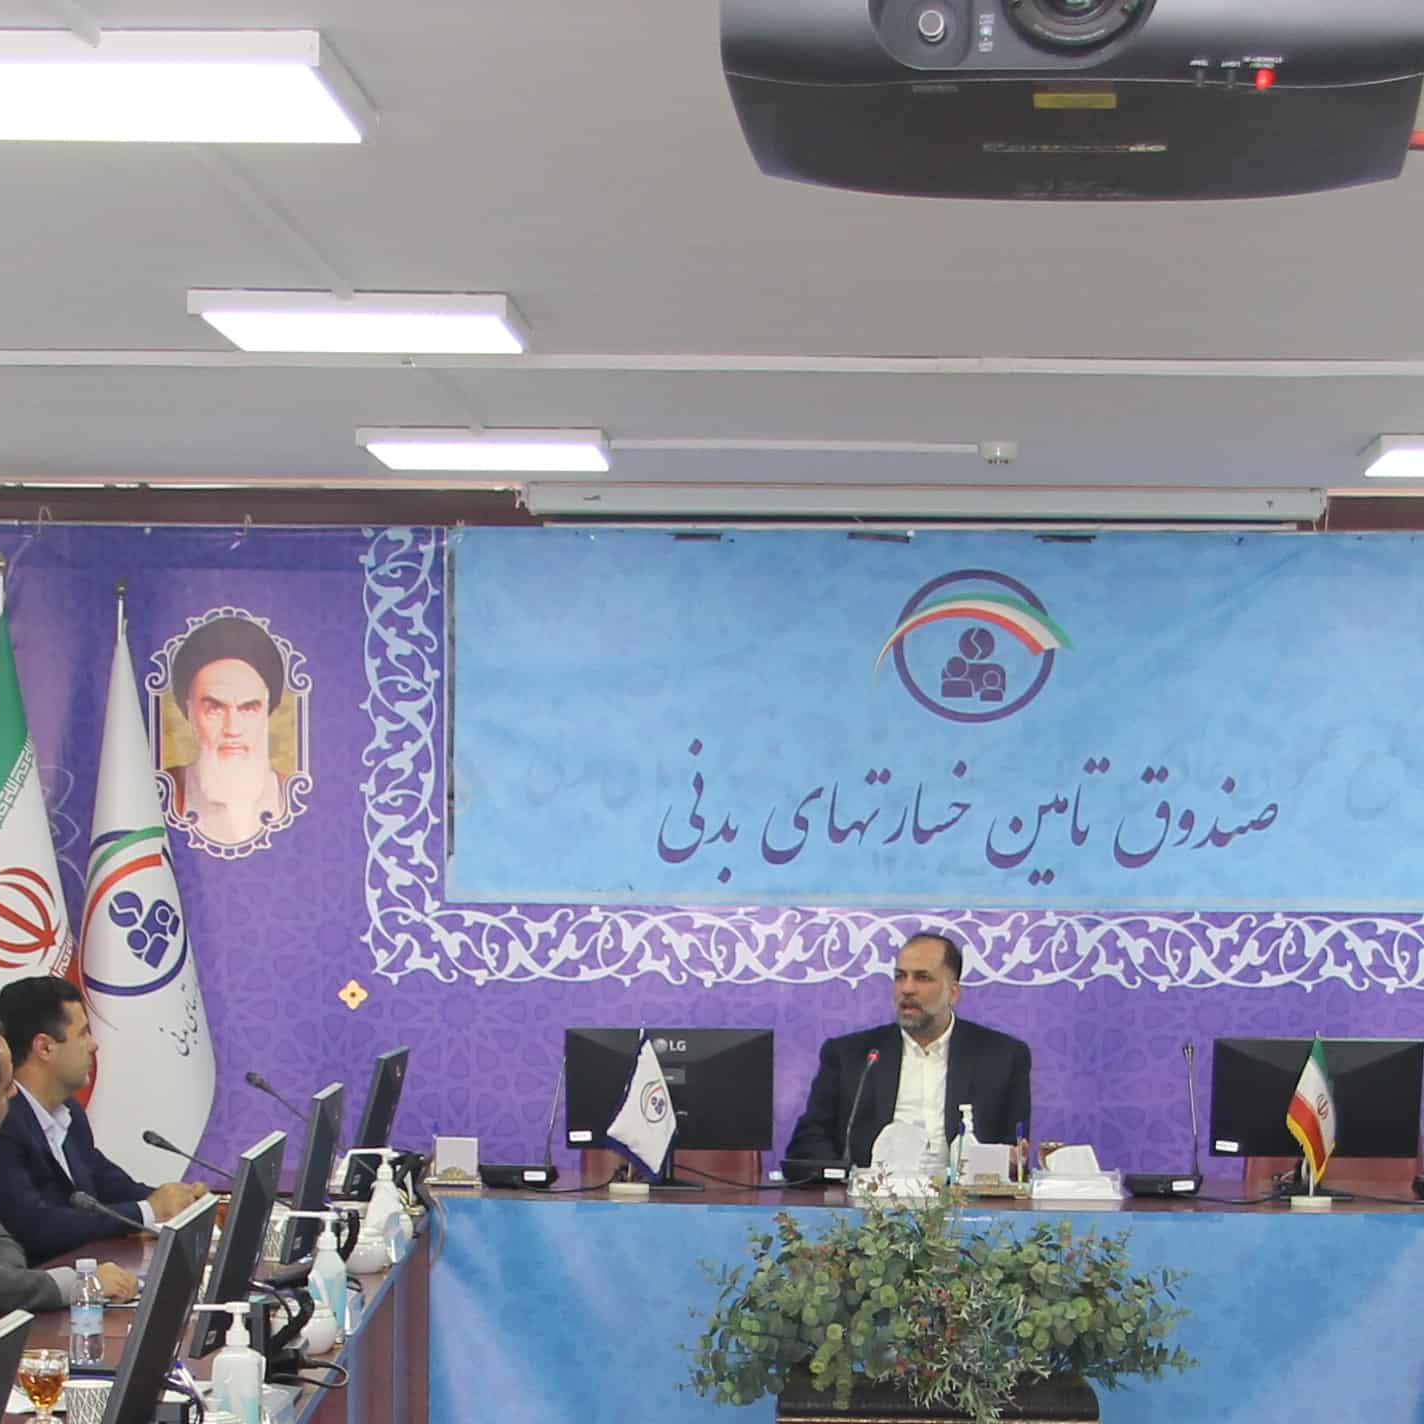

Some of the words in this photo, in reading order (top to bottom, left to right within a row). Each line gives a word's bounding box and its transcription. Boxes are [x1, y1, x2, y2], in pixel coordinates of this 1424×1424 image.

[657, 738, 740, 884] بدنی
[760, 760, 972, 866] خسارتهای
[1113, 765, 1279, 869] صندوق
[669, 1039, 687, 1052] LG
